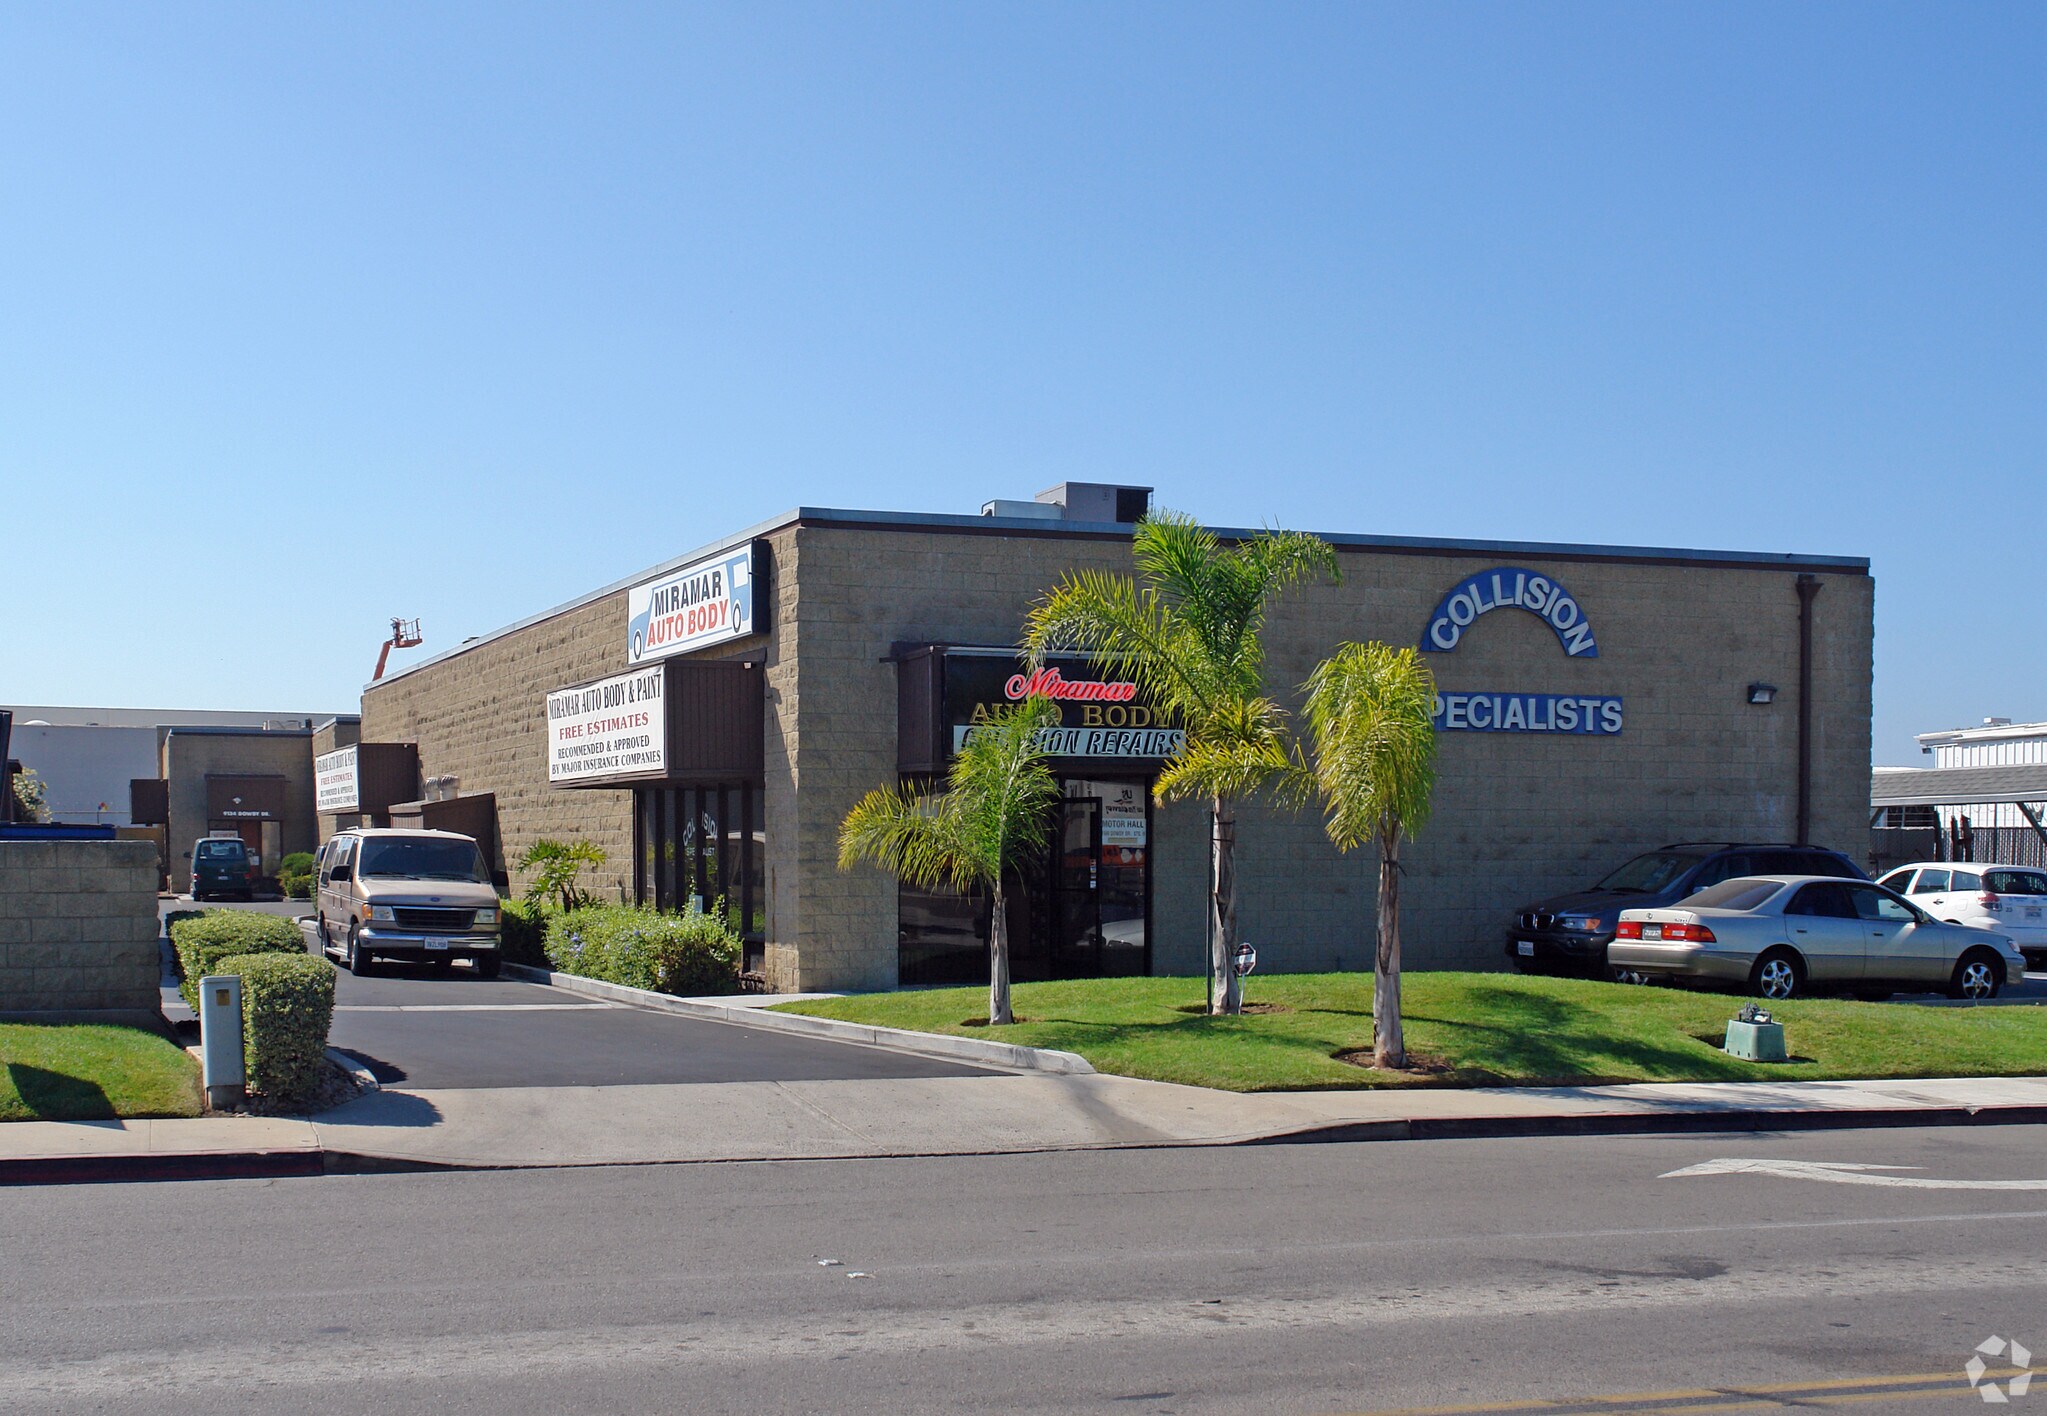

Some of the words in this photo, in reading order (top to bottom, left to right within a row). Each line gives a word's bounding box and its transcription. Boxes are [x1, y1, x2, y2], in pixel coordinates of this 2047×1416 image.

[654, 570, 722, 618] MIRAMAR
[647, 613, 684, 647] AUTO
[687, 599, 728, 636] BODY
[1430, 573, 1595, 656] COLLISION
[549, 694, 580, 720] MIRAMAR
[581, 688, 601, 714] AUTO
[604, 680, 626, 709] BODY
[628, 679, 635, 704] &
[637, 673, 661, 702] PAINT
[1004, 666, 1137, 701] Miramar
[559, 724, 583, 740] FREE
[587, 712, 649, 736] ESTIMATES
[969, 702, 1063, 727] AUO
[1426, 695, 1623, 733] PECIALISTS
[558, 742, 605, 759] RECOMMENDED
[606, 740, 612, 752] &
[613, 734, 650, 752] APPROVED
[1086, 730, 1182, 756] REPAIRS
[552, 764, 560, 775] BY
[561, 760, 582, 774] MAJOR
[583, 755, 619, 771] INSURANCE
[621, 750, 661, 766] COMPANIES
[1127, 820, 1144, 829] HALL
